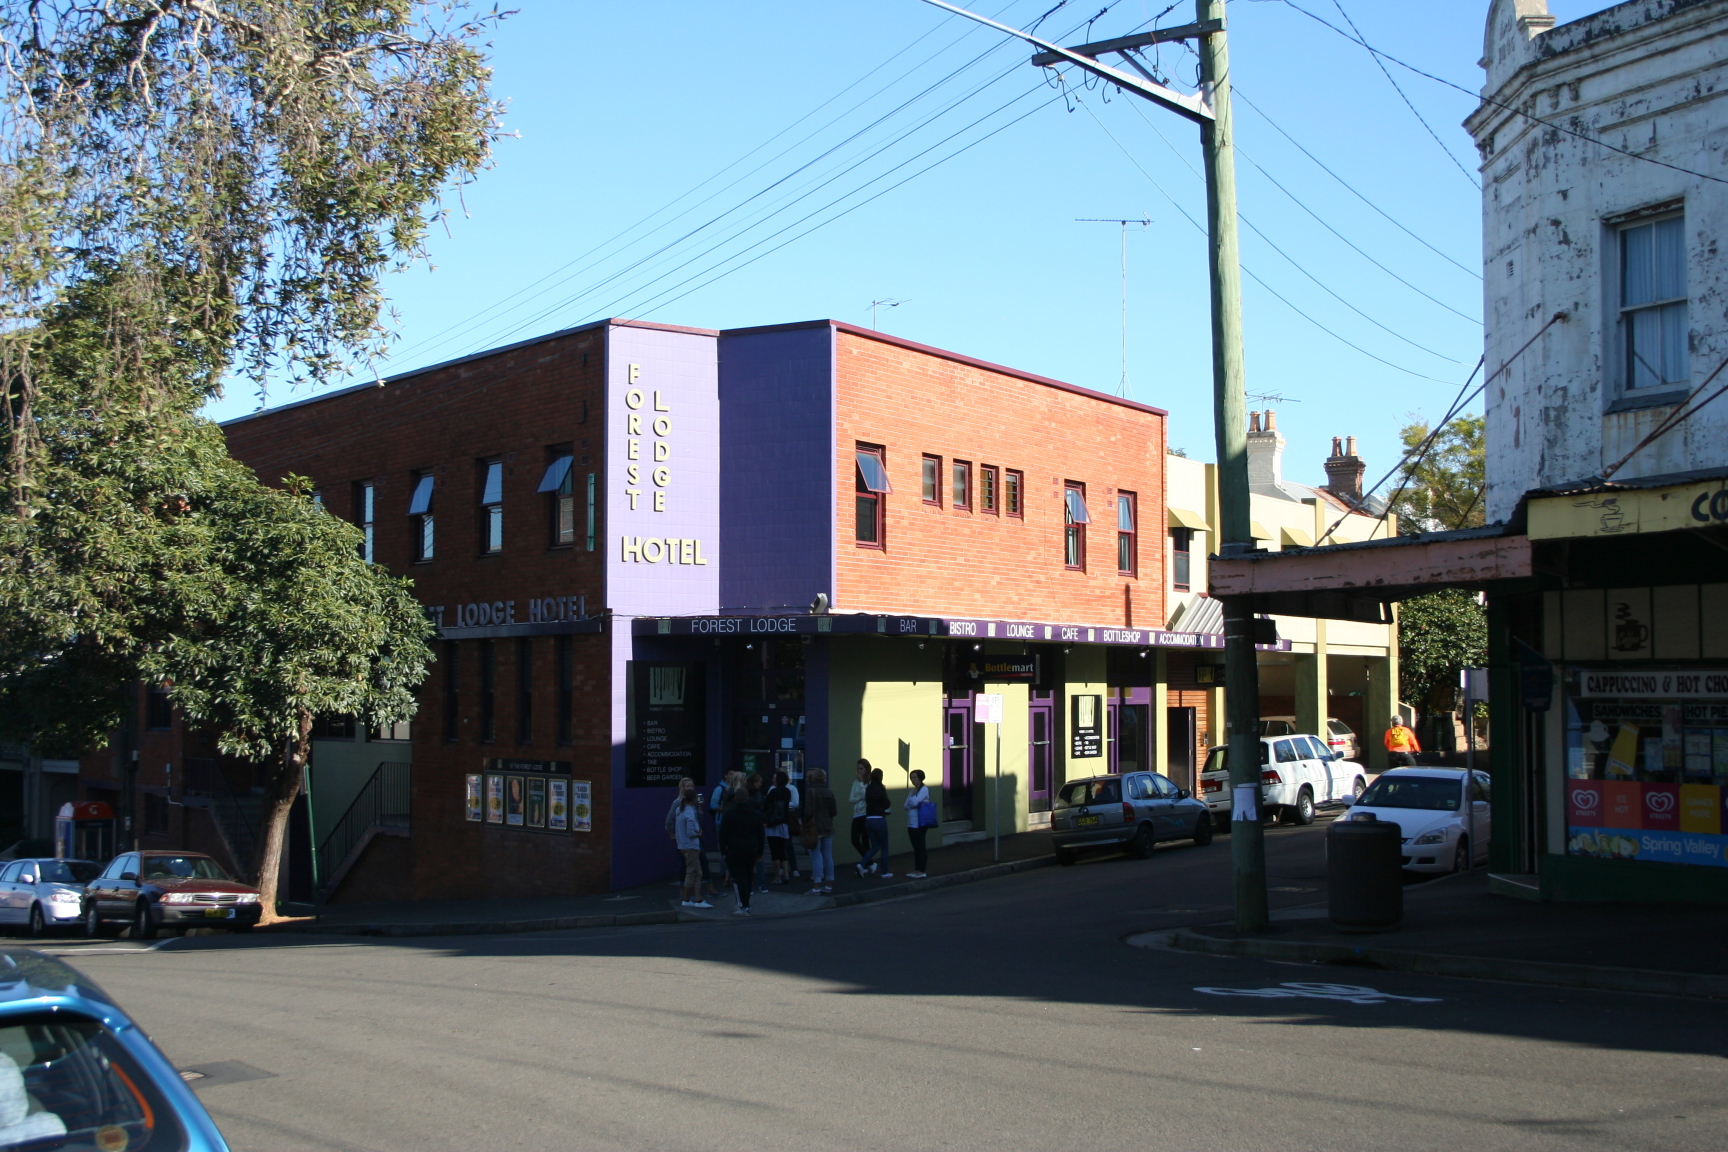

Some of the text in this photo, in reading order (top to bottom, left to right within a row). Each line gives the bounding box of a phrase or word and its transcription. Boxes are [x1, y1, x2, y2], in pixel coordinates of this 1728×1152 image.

[625, 363, 645, 511] FOREST
[653, 390, 673, 513] LODGE
[1691, 489, 1728, 522] CO
[621, 535, 708, 566] HOTEL
[457, 600, 515, 627] LODGE
[529, 595, 588, 623] HOTEL
[691, 618, 797, 634] FOREST LODGE
[899, 618, 917, 634] BAR
[949, 621, 977, 637] BISTRO
[1006, 624, 1034, 639] LOUNGE
[1061, 627, 1079, 640] CAFE
[1103, 630, 1141, 643] BOTTLESHOP
[985, 662, 1034, 673] Bottlemart
[1587, 675, 1728, 693] CAPPUCCINO & HOT CHO
[1594, 705, 1662, 718] SANDWICHES
[1686, 706, 1707, 718] HOT
[1616, 794, 1628, 803] ICE
[1615, 805, 1629, 814] HOT
[1649, 812, 1672, 820] STREETS
[1641, 835, 1720, 858] Spring Valley
